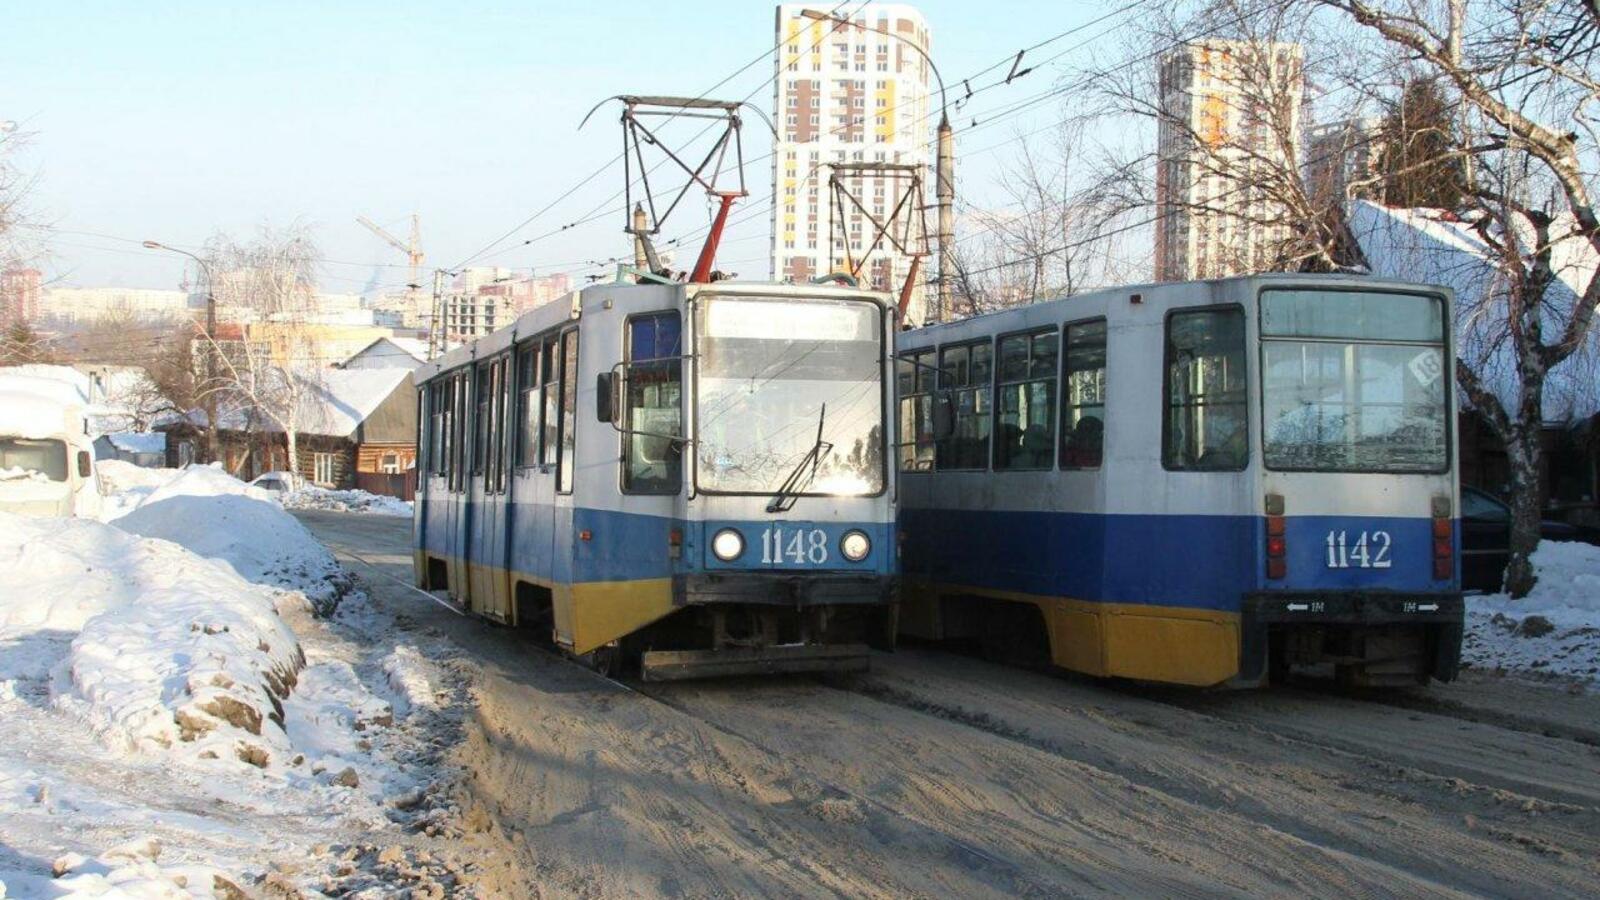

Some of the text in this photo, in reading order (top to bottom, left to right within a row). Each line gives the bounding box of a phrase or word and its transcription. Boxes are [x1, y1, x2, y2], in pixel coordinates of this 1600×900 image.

[1416, 355, 1440, 379] 18
[761, 529, 826, 564] 1148
[1326, 530, 1392, 568] 1142
